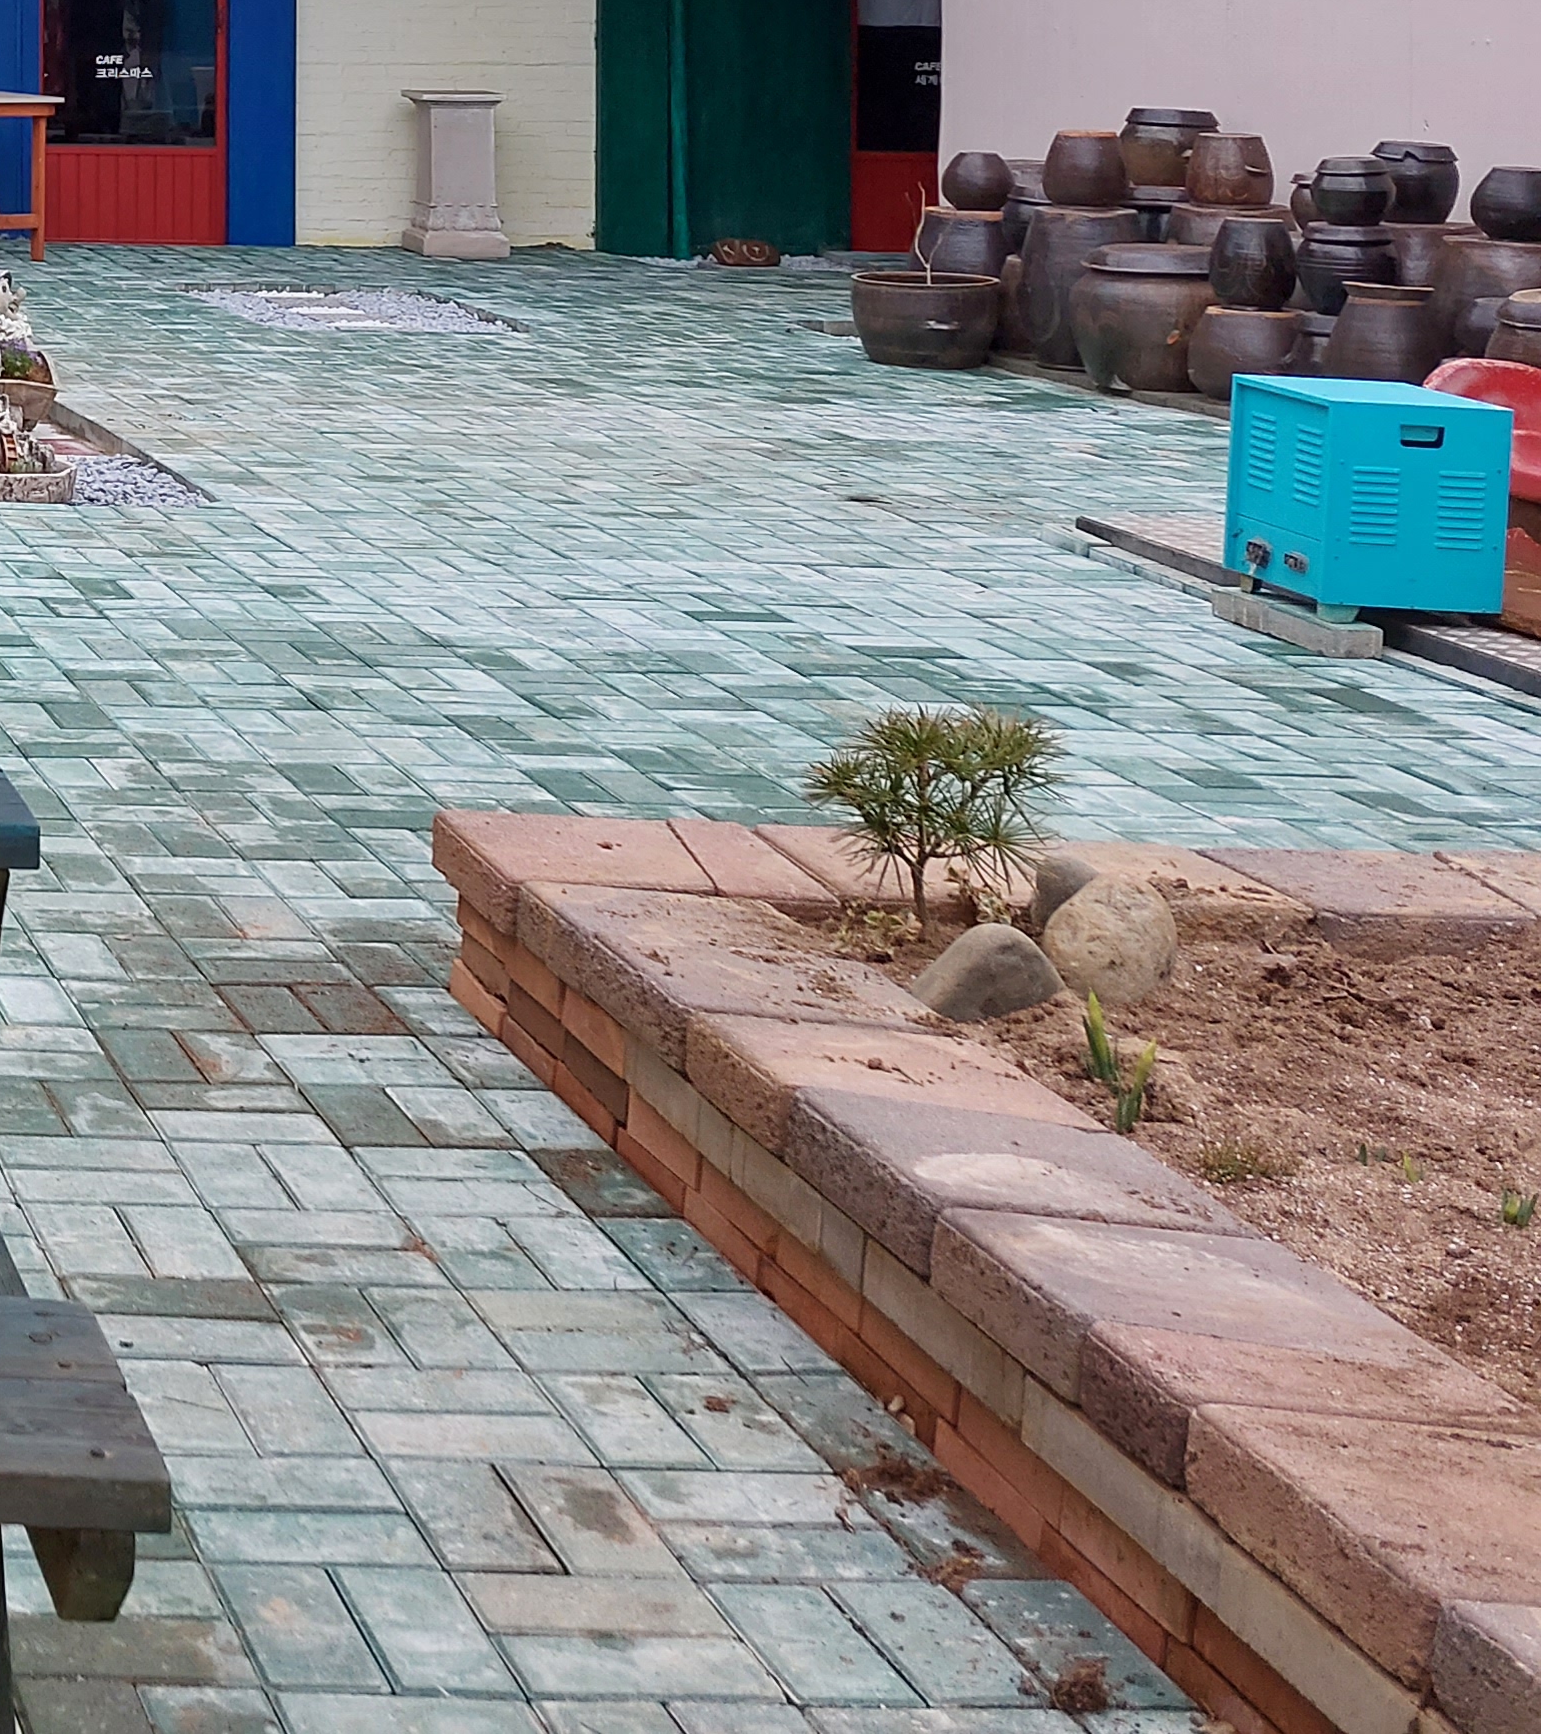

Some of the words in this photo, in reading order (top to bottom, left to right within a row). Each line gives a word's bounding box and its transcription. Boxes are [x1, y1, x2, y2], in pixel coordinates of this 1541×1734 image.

[95, 54, 124, 65] CAFE
[914, 62, 941, 71] CAFE
[95, 67, 153, 79] 크리스마스
[914, 74, 941, 86] 세계
